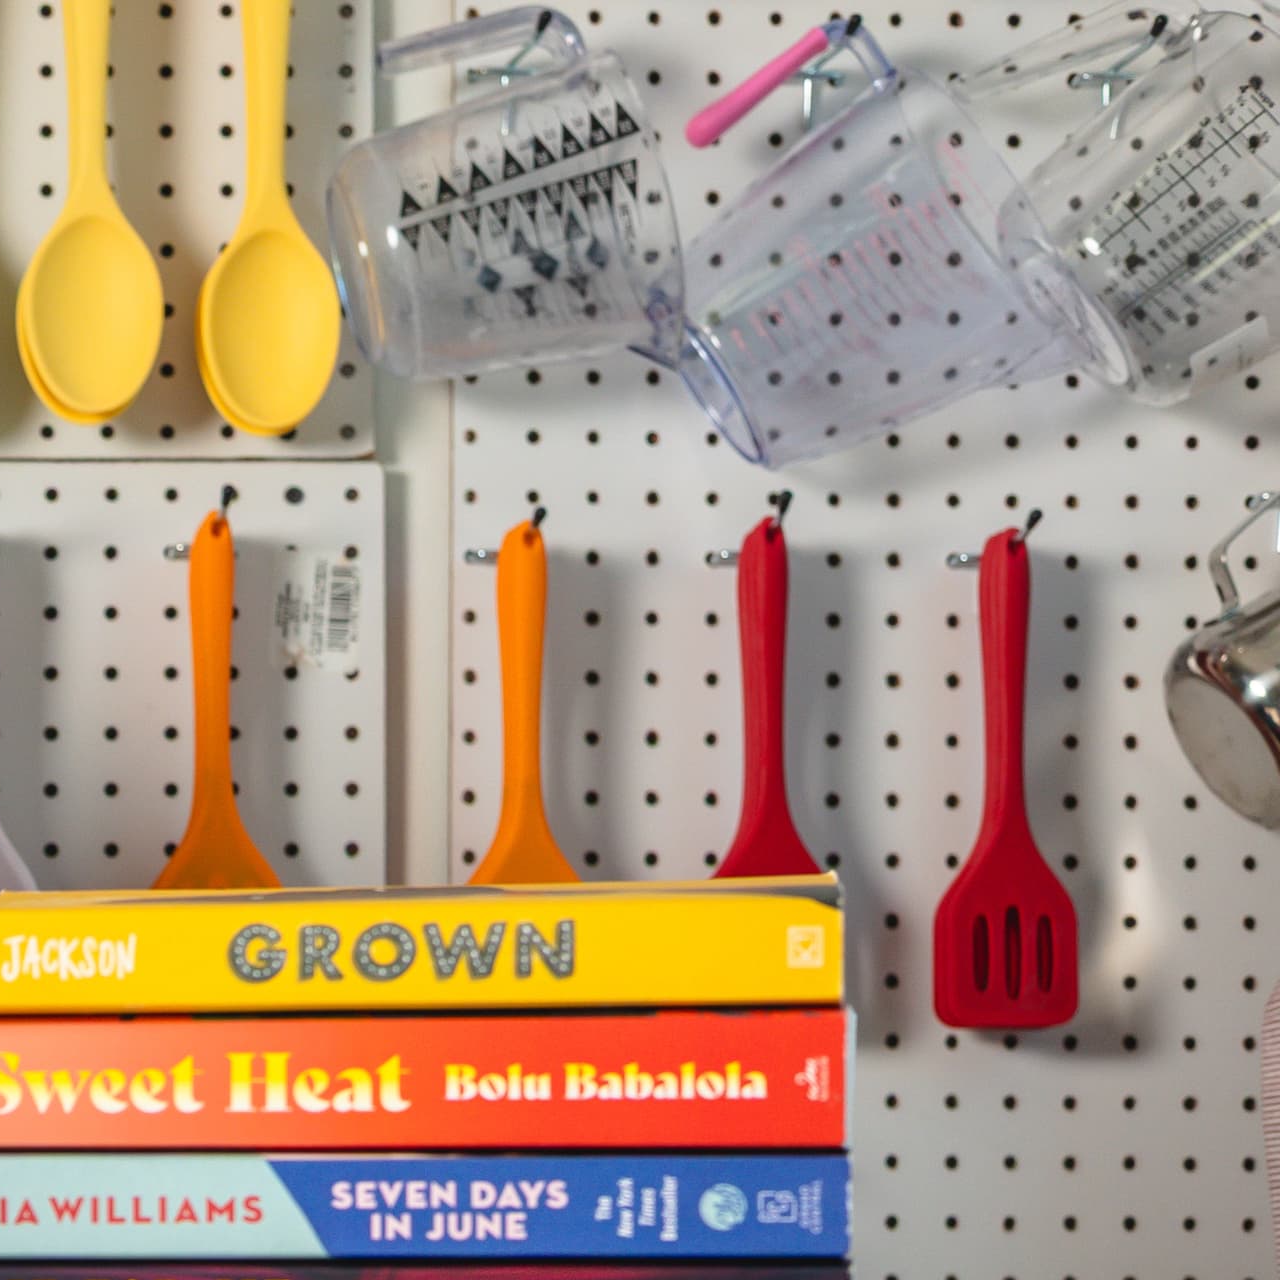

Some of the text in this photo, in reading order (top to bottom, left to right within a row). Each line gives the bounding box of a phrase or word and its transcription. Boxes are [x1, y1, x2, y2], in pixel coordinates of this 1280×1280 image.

[1, 933, 138, 984] JACKSON
[226, 919, 576, 984] GROWN
[225, 1050, 413, 1115] Heat
[443, 1062, 552, 1102] Bolu
[563, 1060, 768, 1102] Babalola
[48, 1195, 264, 1225] WILLIAMS
[331, 1180, 570, 1211] SEVEN DAYS
[594, 1194, 613, 1222] The
[616, 1176, 634, 1239] New York
[370, 1213, 528, 1241] IN JUNE
